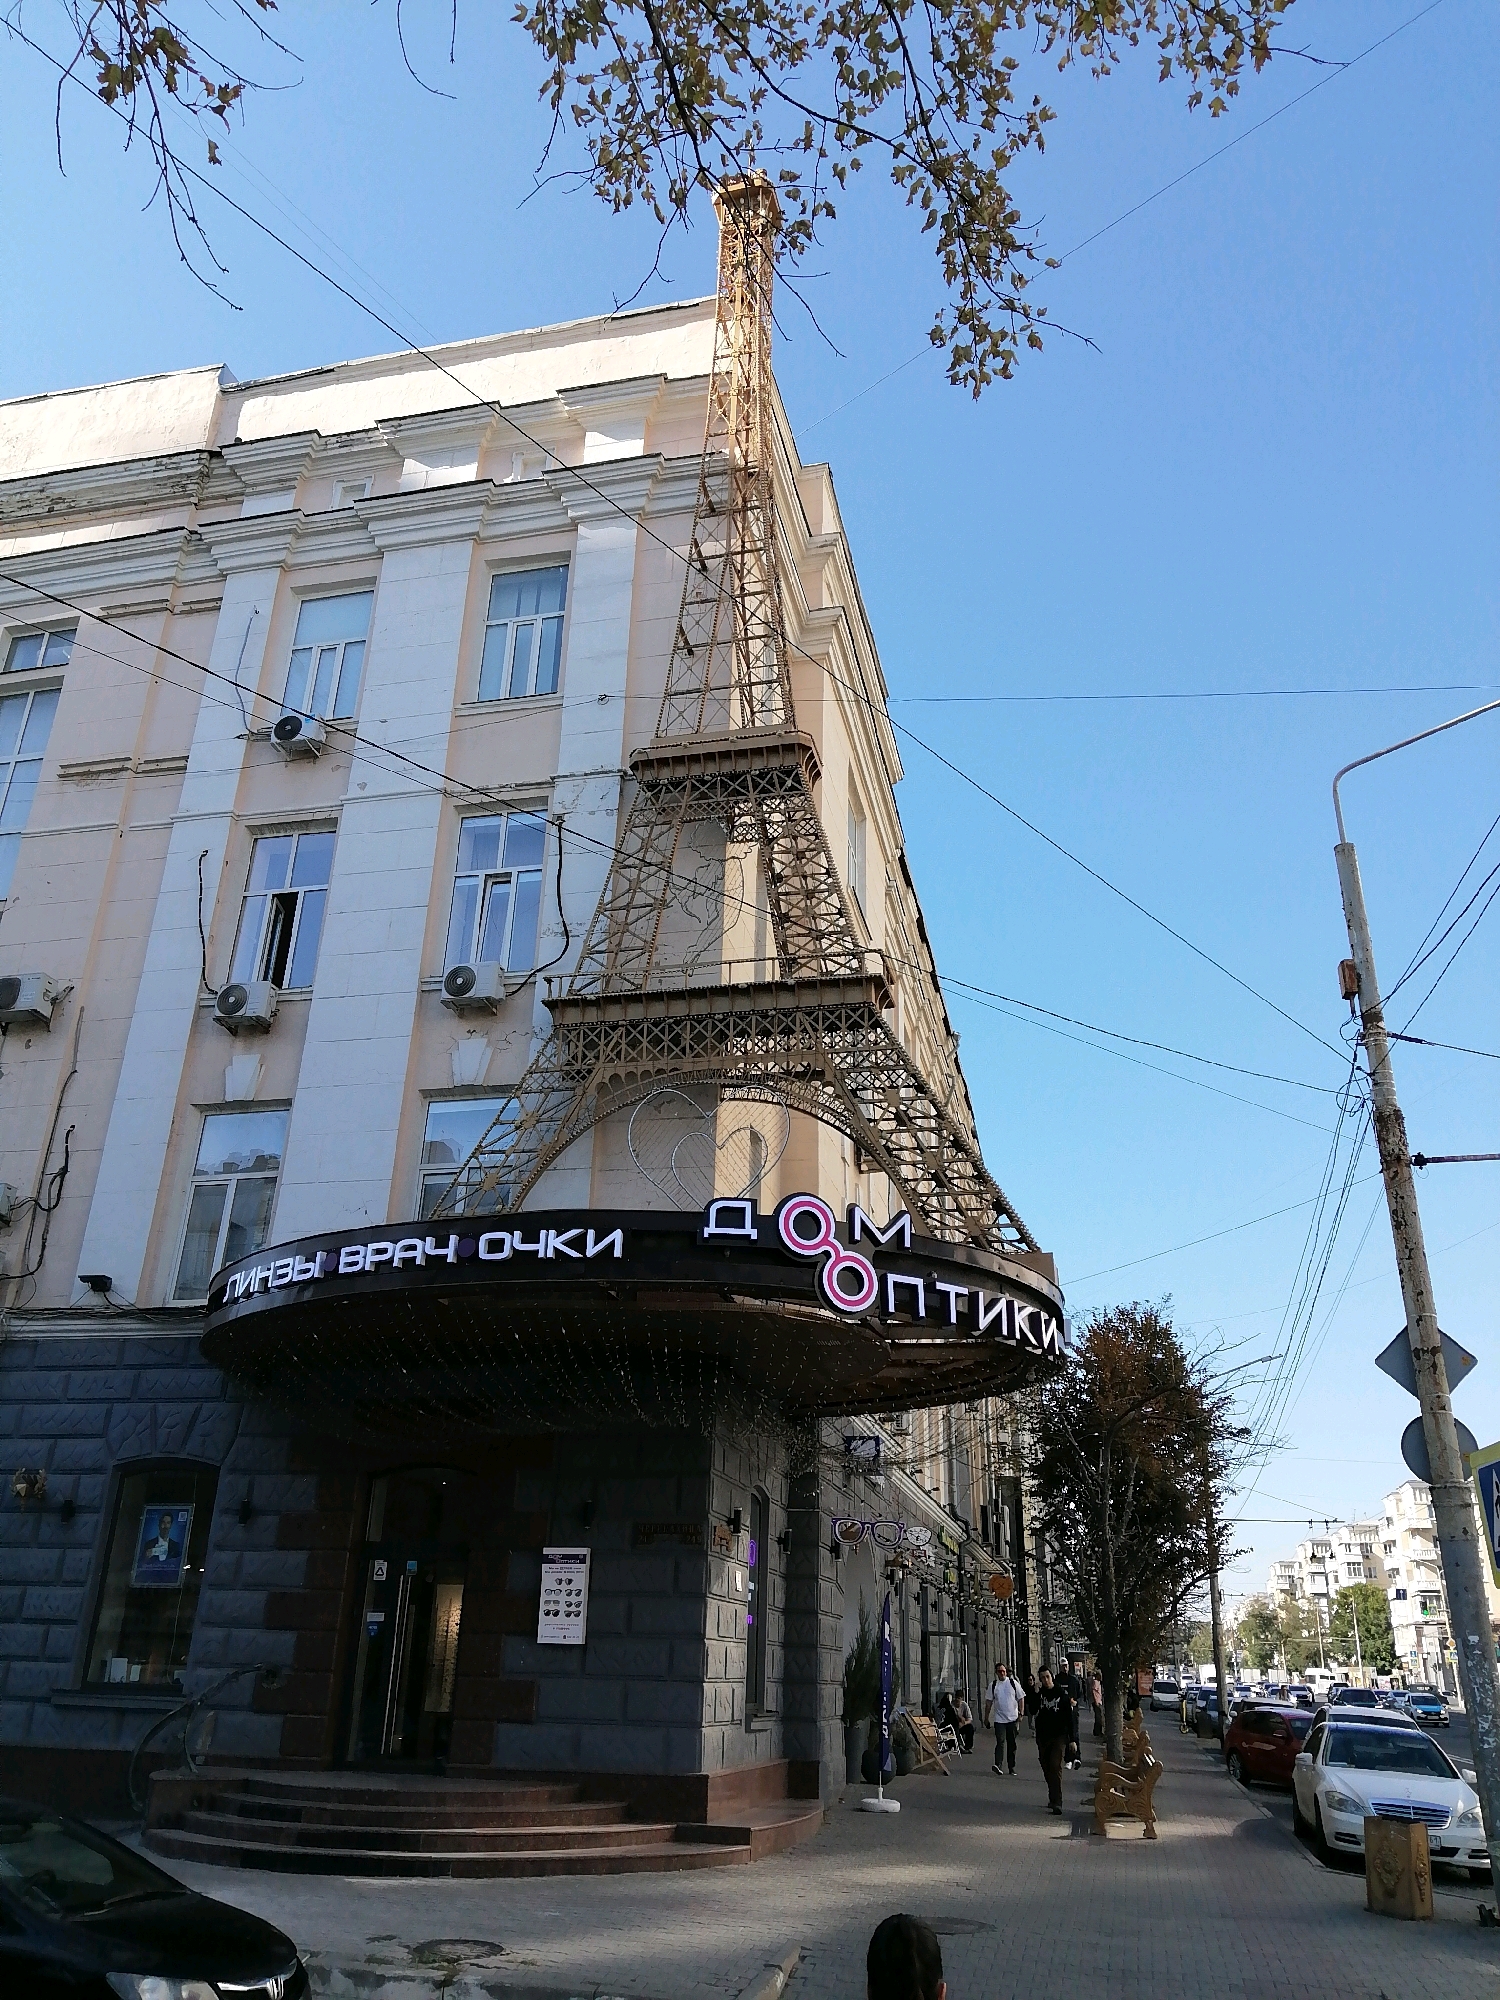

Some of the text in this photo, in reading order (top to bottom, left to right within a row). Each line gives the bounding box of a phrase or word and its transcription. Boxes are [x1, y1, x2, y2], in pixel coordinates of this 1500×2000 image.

[703, 1196, 911, 1256] ДОМ
[222, 1228, 623, 1303] ЛИНЗЫ ВРАЧ ОЧКИ
[823, 1250, 1060, 1356] ОПТИКИ
